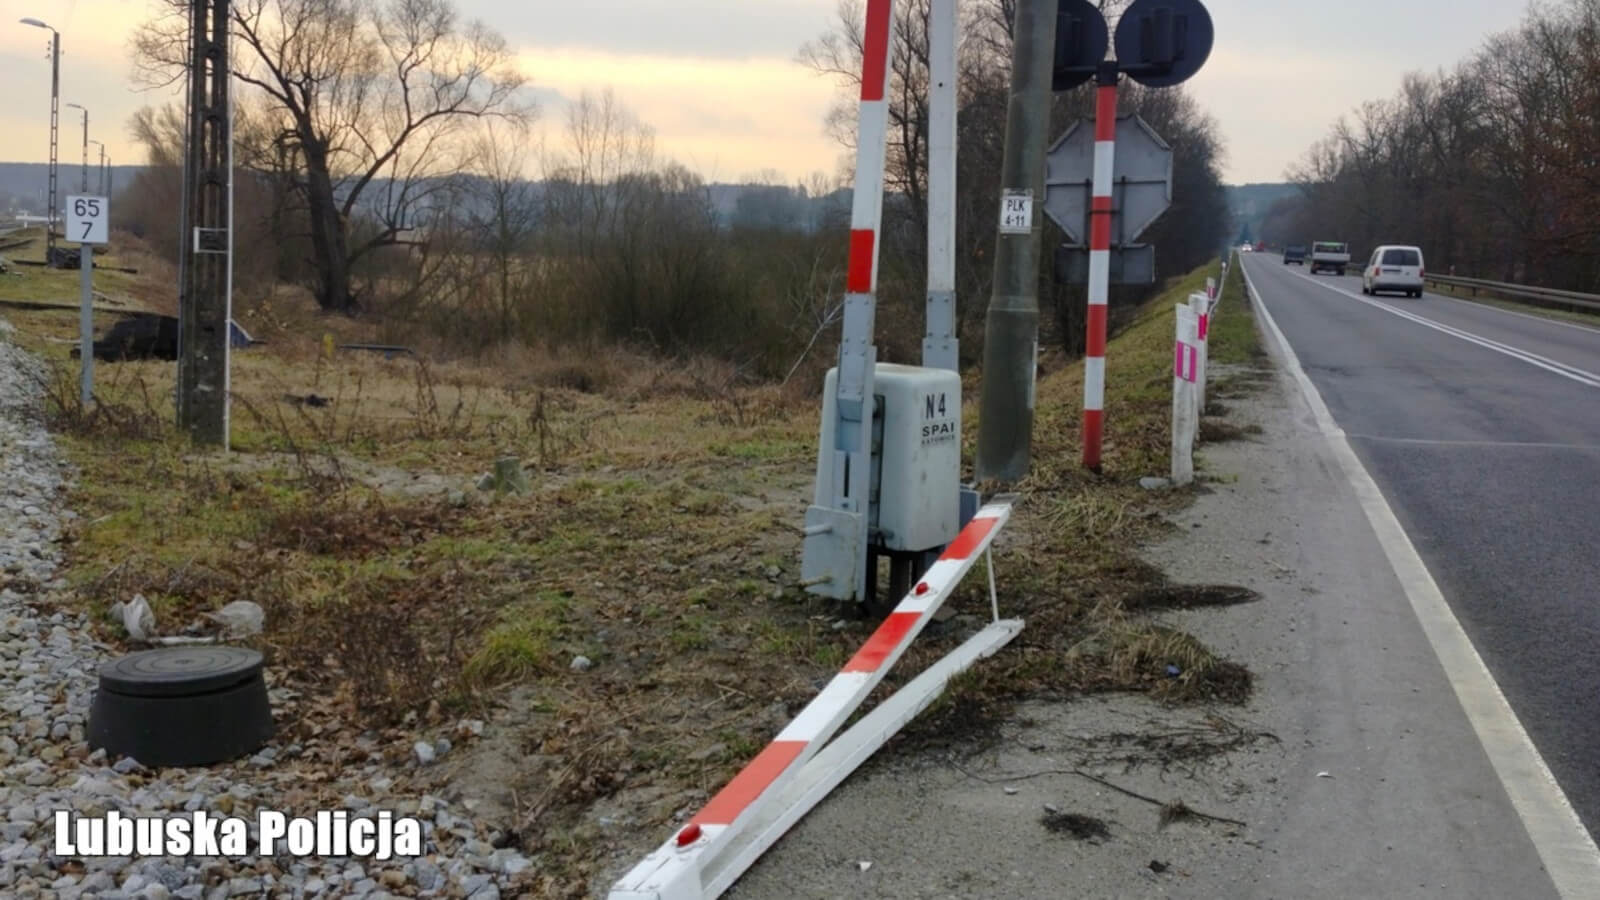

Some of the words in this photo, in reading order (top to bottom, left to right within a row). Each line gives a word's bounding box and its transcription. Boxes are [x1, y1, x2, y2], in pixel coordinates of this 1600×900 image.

[75, 198, 100, 217] 65
[1007, 199, 1025, 211] PLK
[1005, 214, 1025, 226] 4-11
[81, 221, 94, 240] 7
[922, 421, 954, 437] SPAI
